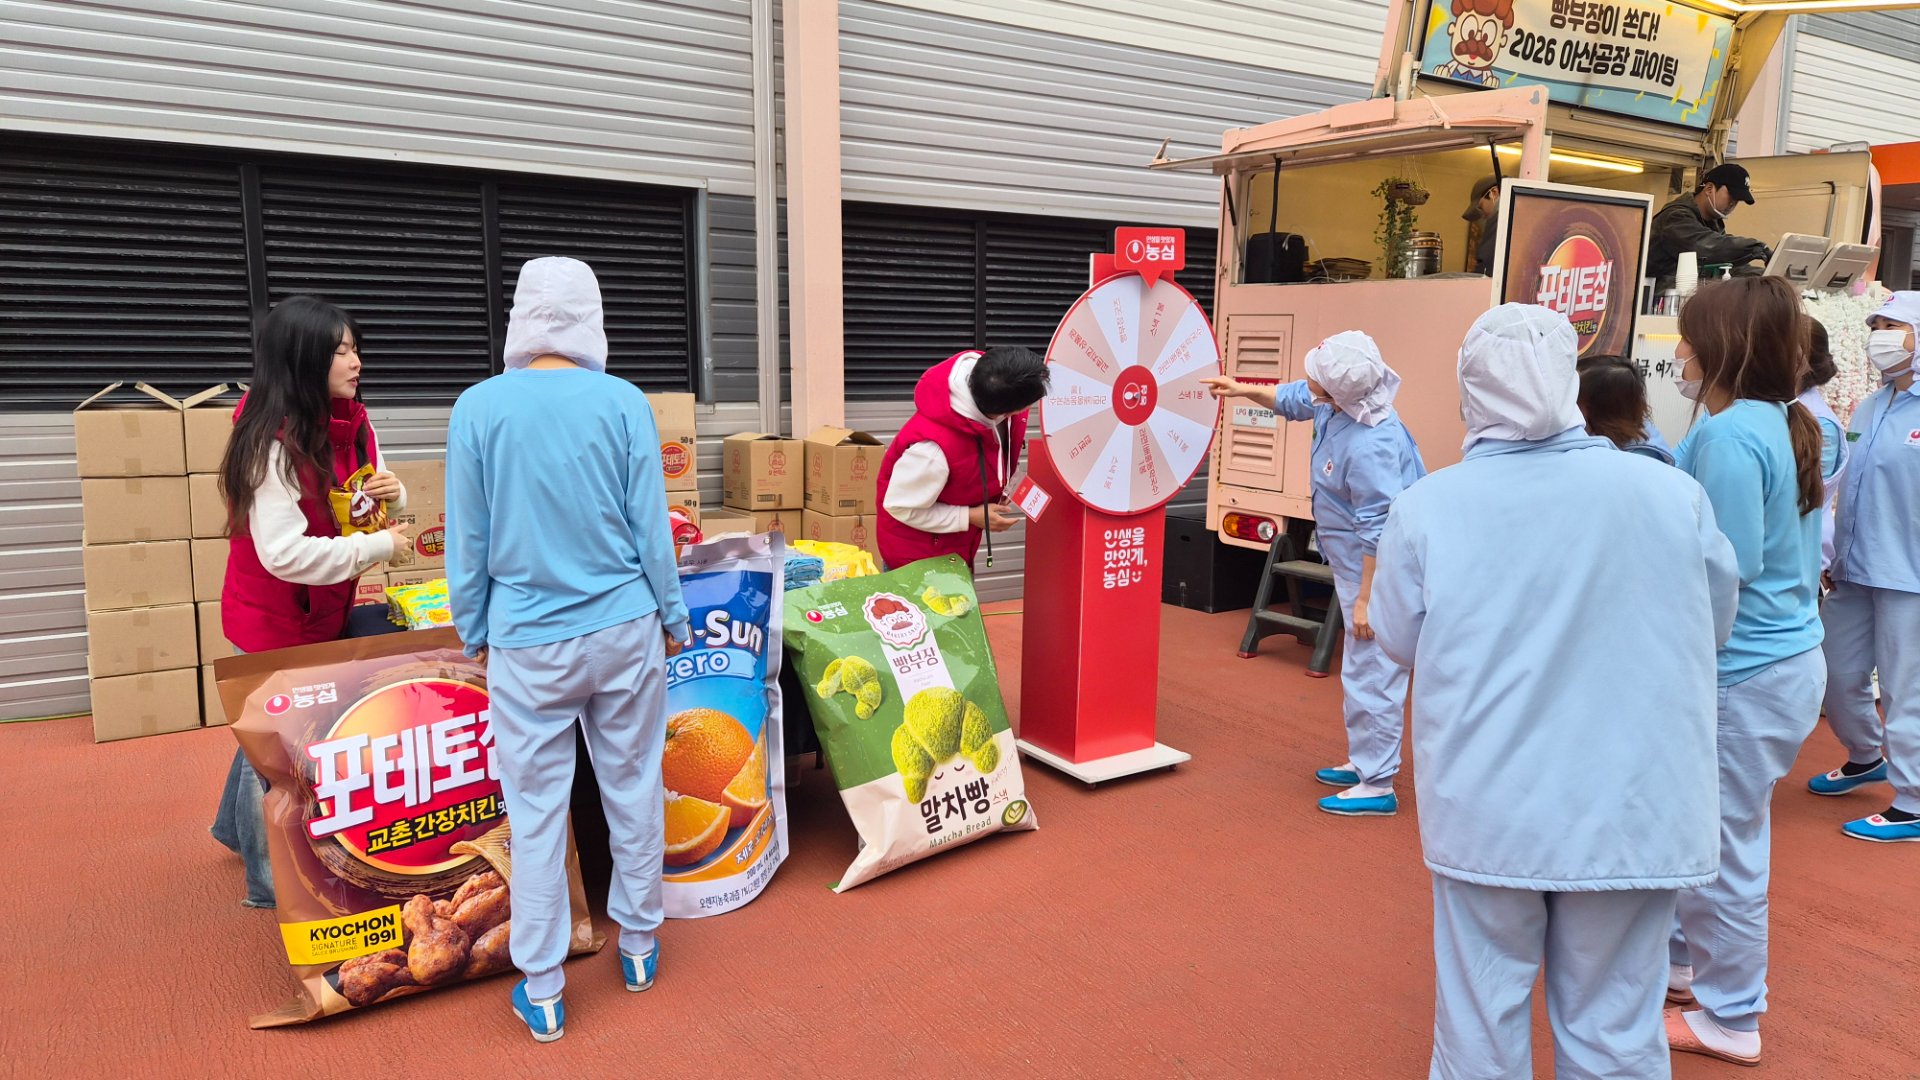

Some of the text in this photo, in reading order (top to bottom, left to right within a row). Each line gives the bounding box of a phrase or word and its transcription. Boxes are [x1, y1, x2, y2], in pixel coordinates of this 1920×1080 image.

[1509, 28, 1679, 87] 2026 아산공장 파이팅
[1145, 244, 1175, 261] 농심
[1537, 260, 1613, 316] 포테토칩
[1636, 359, 1651, 378] 금,
[1178, 391, 1192, 400] 스낵
[683, 499, 698, 508] 50 g
[1026, 491, 1042, 512] STAFF
[1104, 527, 1145, 548] 인생을
[1104, 548, 1148, 570] 맛있게,
[1103, 569, 1130, 589] 농심
[666, 650, 731, 685] zero
[892, 647, 939, 675] 빵부장
[293, 689, 338, 708] 농심
[920, 777, 1009, 834] 말차빵 스낵
[367, 820, 413, 853] 교촌
[929, 816, 992, 849] Matcha Bread
[746, 865, 757, 880] 200
[310, 913, 395, 942] KYOCHON
[312, 938, 357, 952] SIGNATURE
